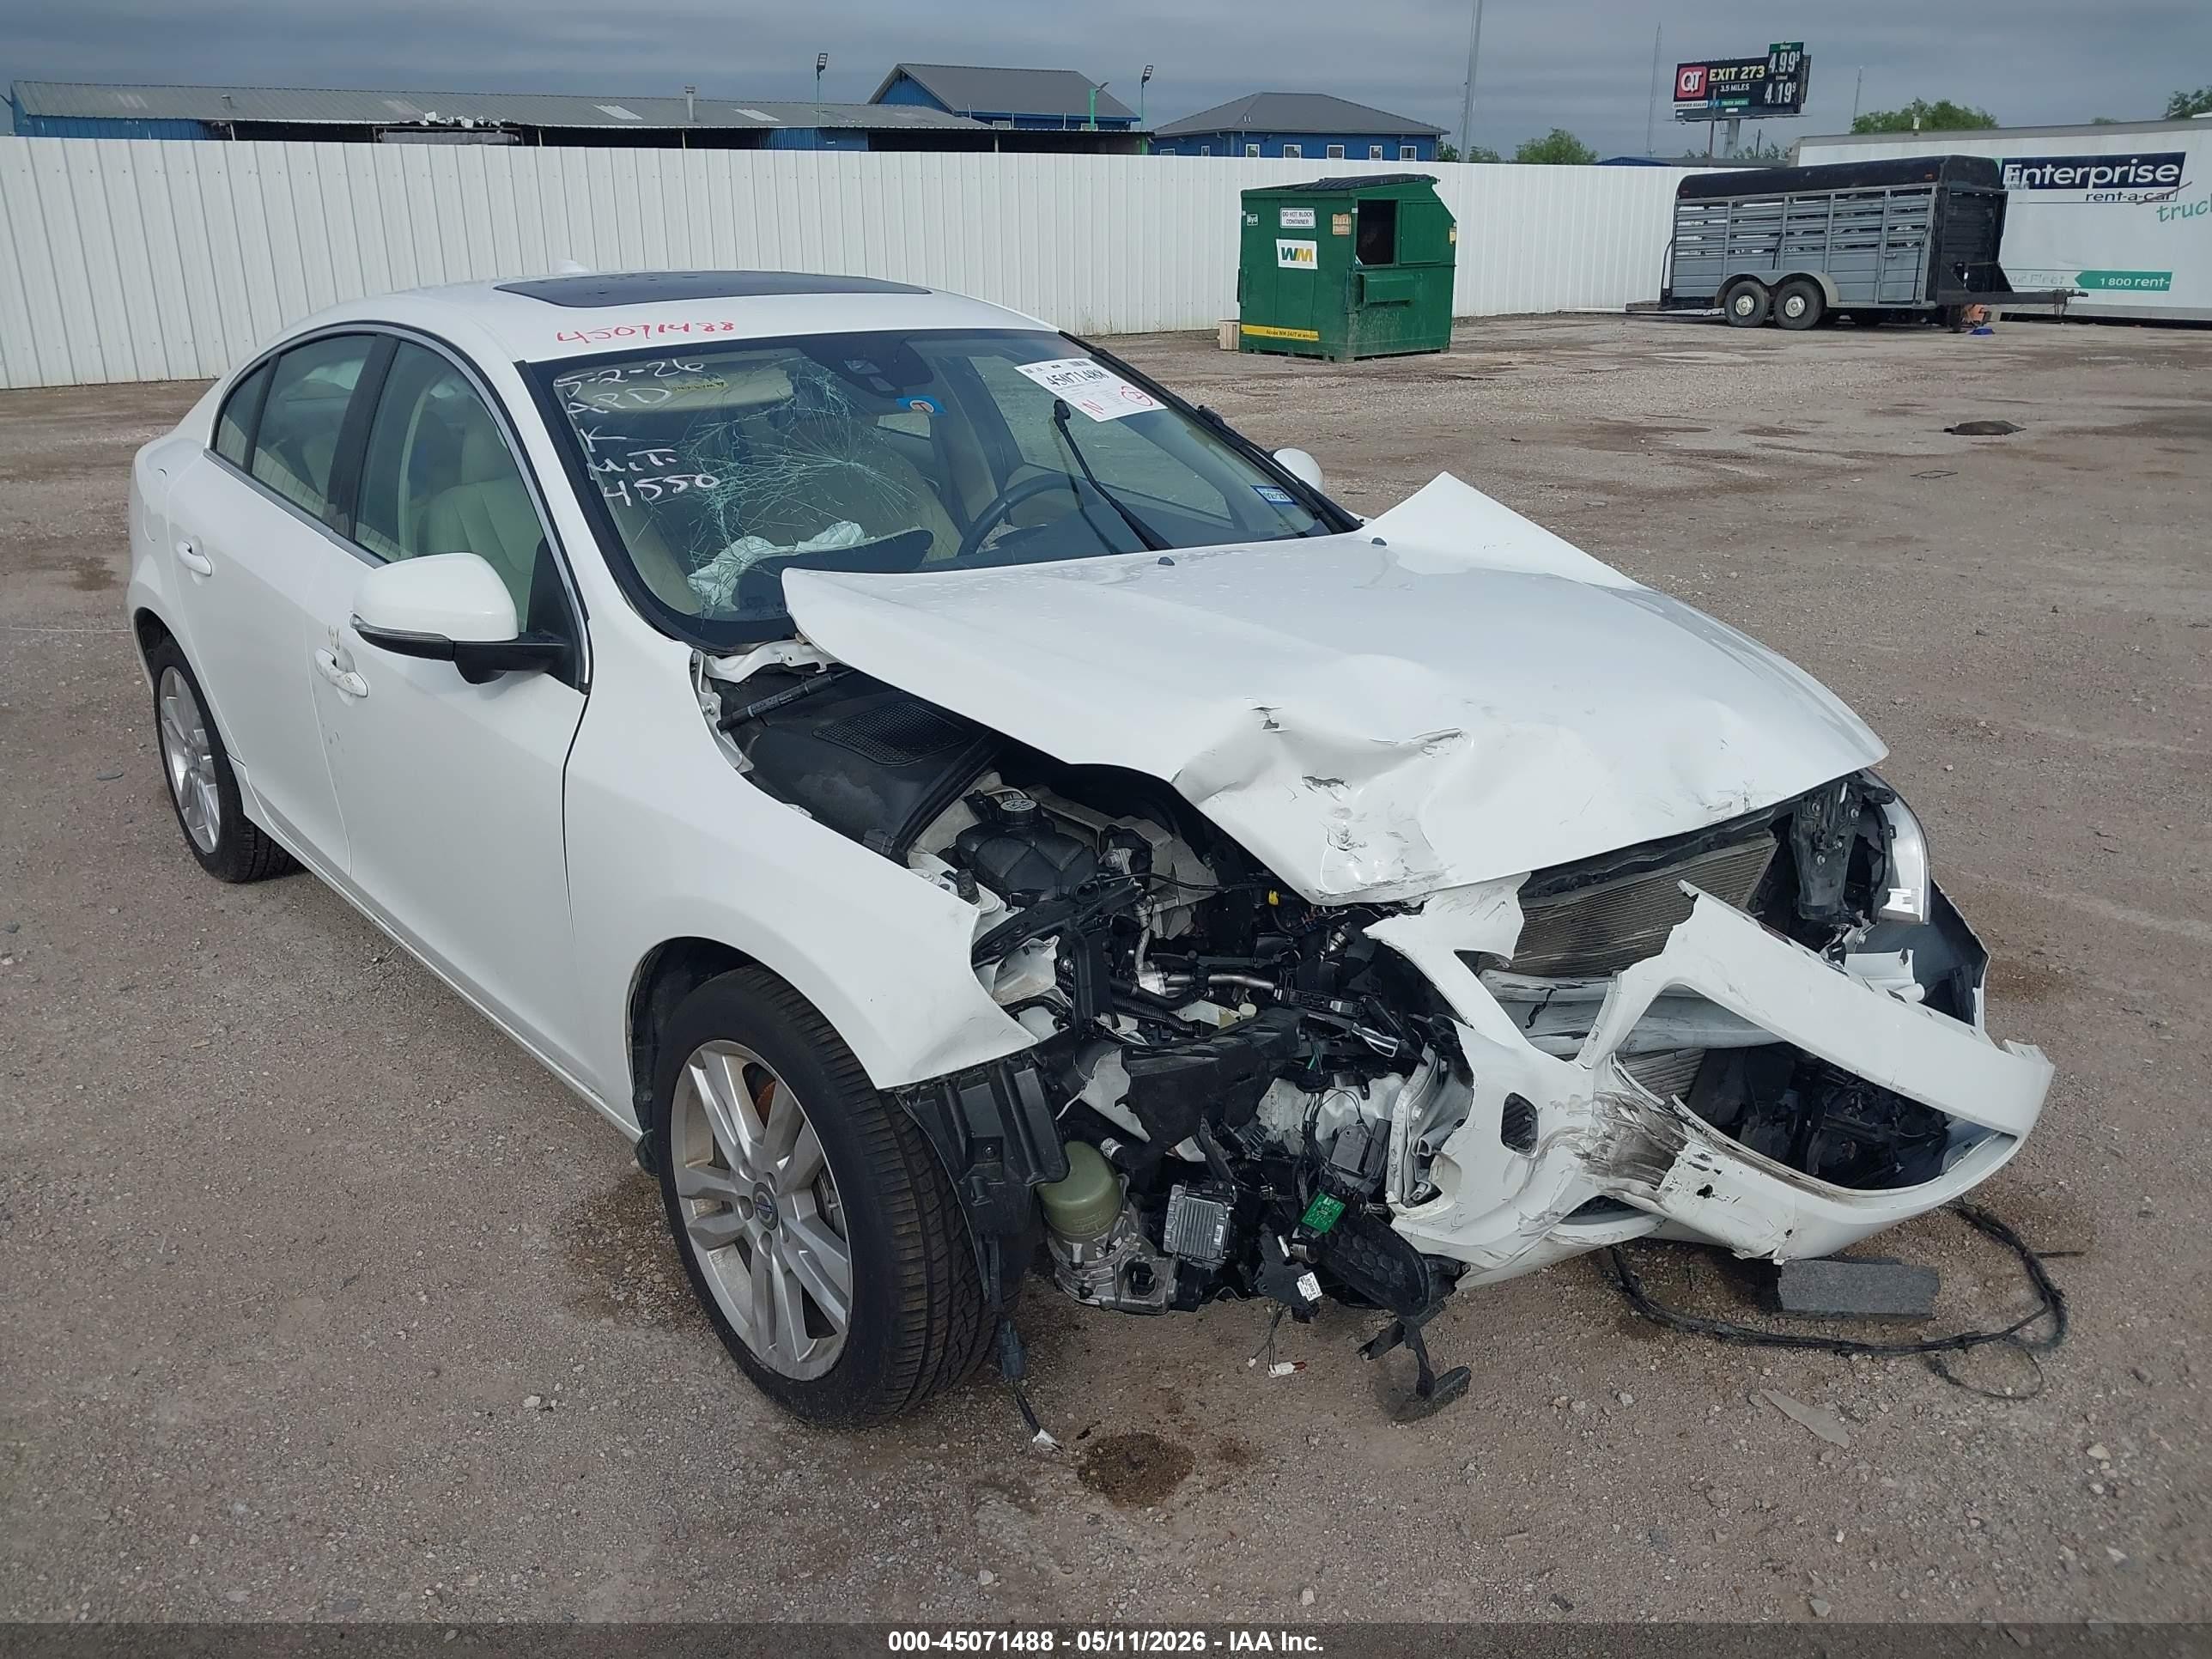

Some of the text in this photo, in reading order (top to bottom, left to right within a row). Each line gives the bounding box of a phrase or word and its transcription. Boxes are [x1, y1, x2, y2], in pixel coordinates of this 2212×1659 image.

[1709, 64, 1765, 82] EXIT 273
[1680, 70, 1702, 93] QT
[1731, 83, 1749, 92] MILES
[2002, 158, 2179, 189] Enterprise
[2086, 191, 2174, 202] rent-a-car
[1281, 246, 1313, 262] WM
[2108, 277, 2130, 286] 800
[1046, 369, 1109, 386] 45071488
